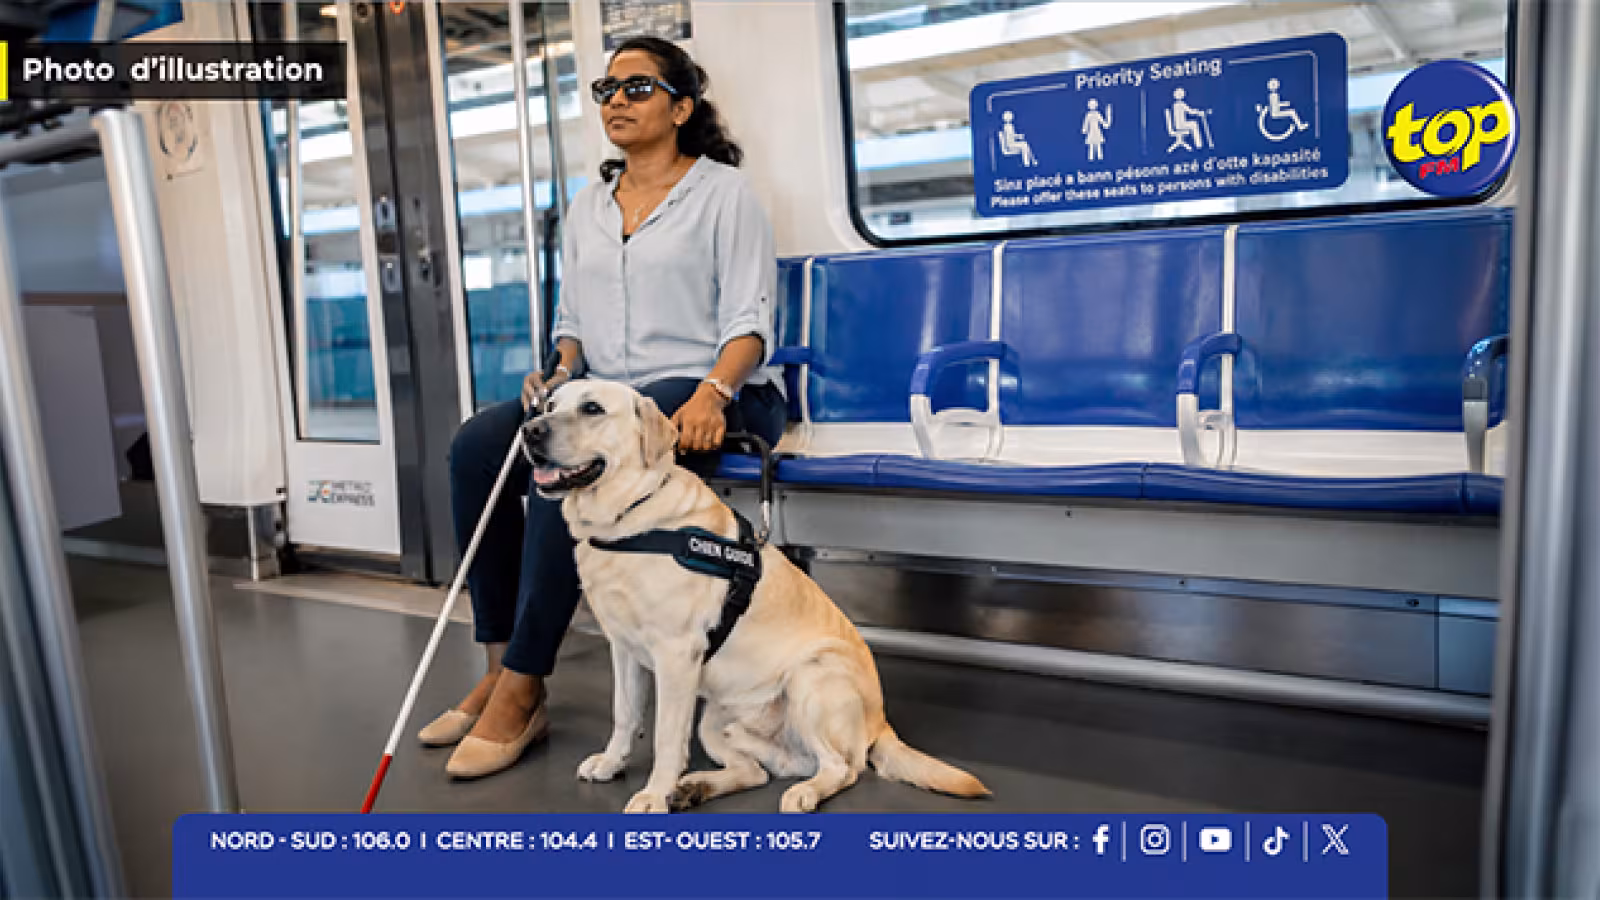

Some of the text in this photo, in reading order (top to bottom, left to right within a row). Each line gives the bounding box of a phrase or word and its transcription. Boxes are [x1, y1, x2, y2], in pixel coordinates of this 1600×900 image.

[1075, 57, 1222, 92] Priority Seating
[991, 165, 1329, 208] Please offer these seats to persons with disabilities
[1077, 169, 1113, 185] bann
